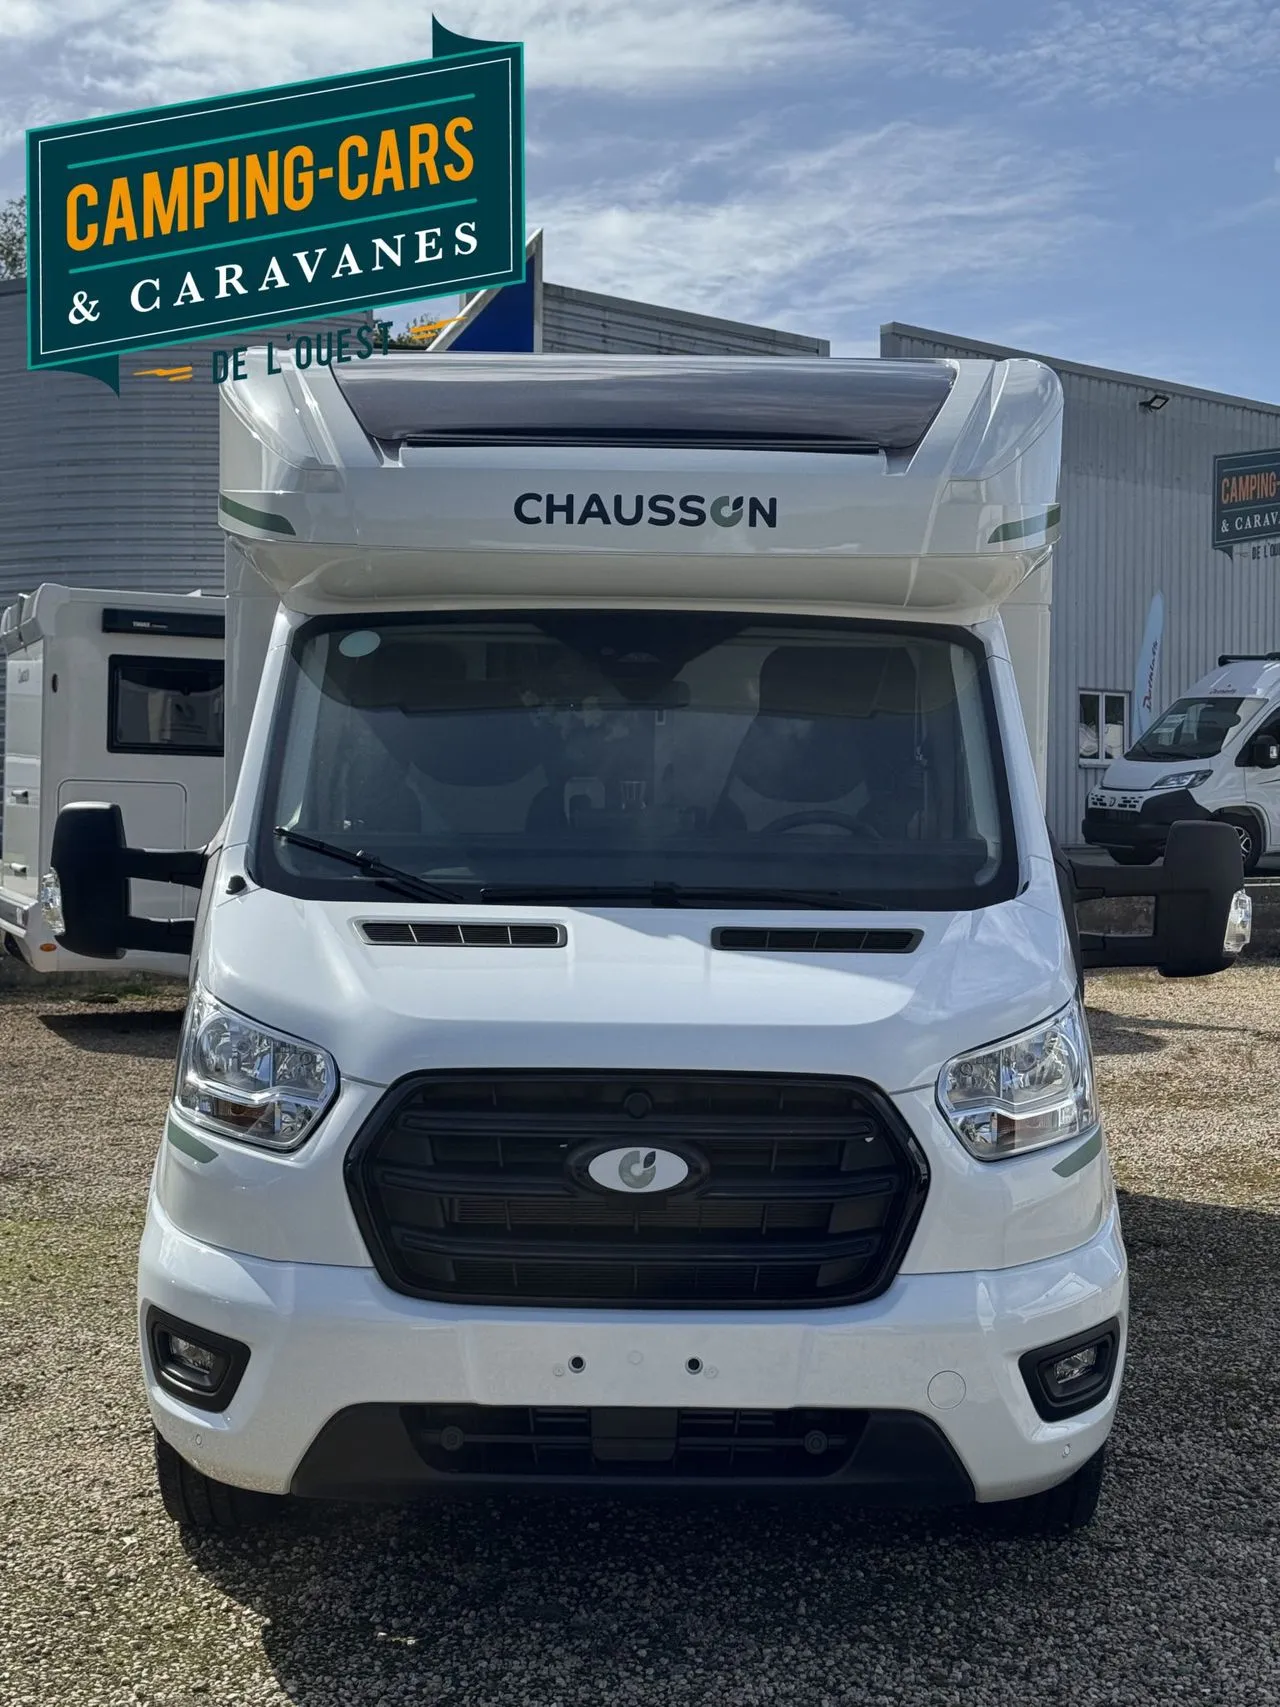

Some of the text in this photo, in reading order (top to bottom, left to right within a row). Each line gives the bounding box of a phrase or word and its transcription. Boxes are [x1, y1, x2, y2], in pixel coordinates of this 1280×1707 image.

[513, 492, 778, 528] CHAUSSON
[1221, 519, 1230, 533] &
[1252, 545, 1261, 560] DE
